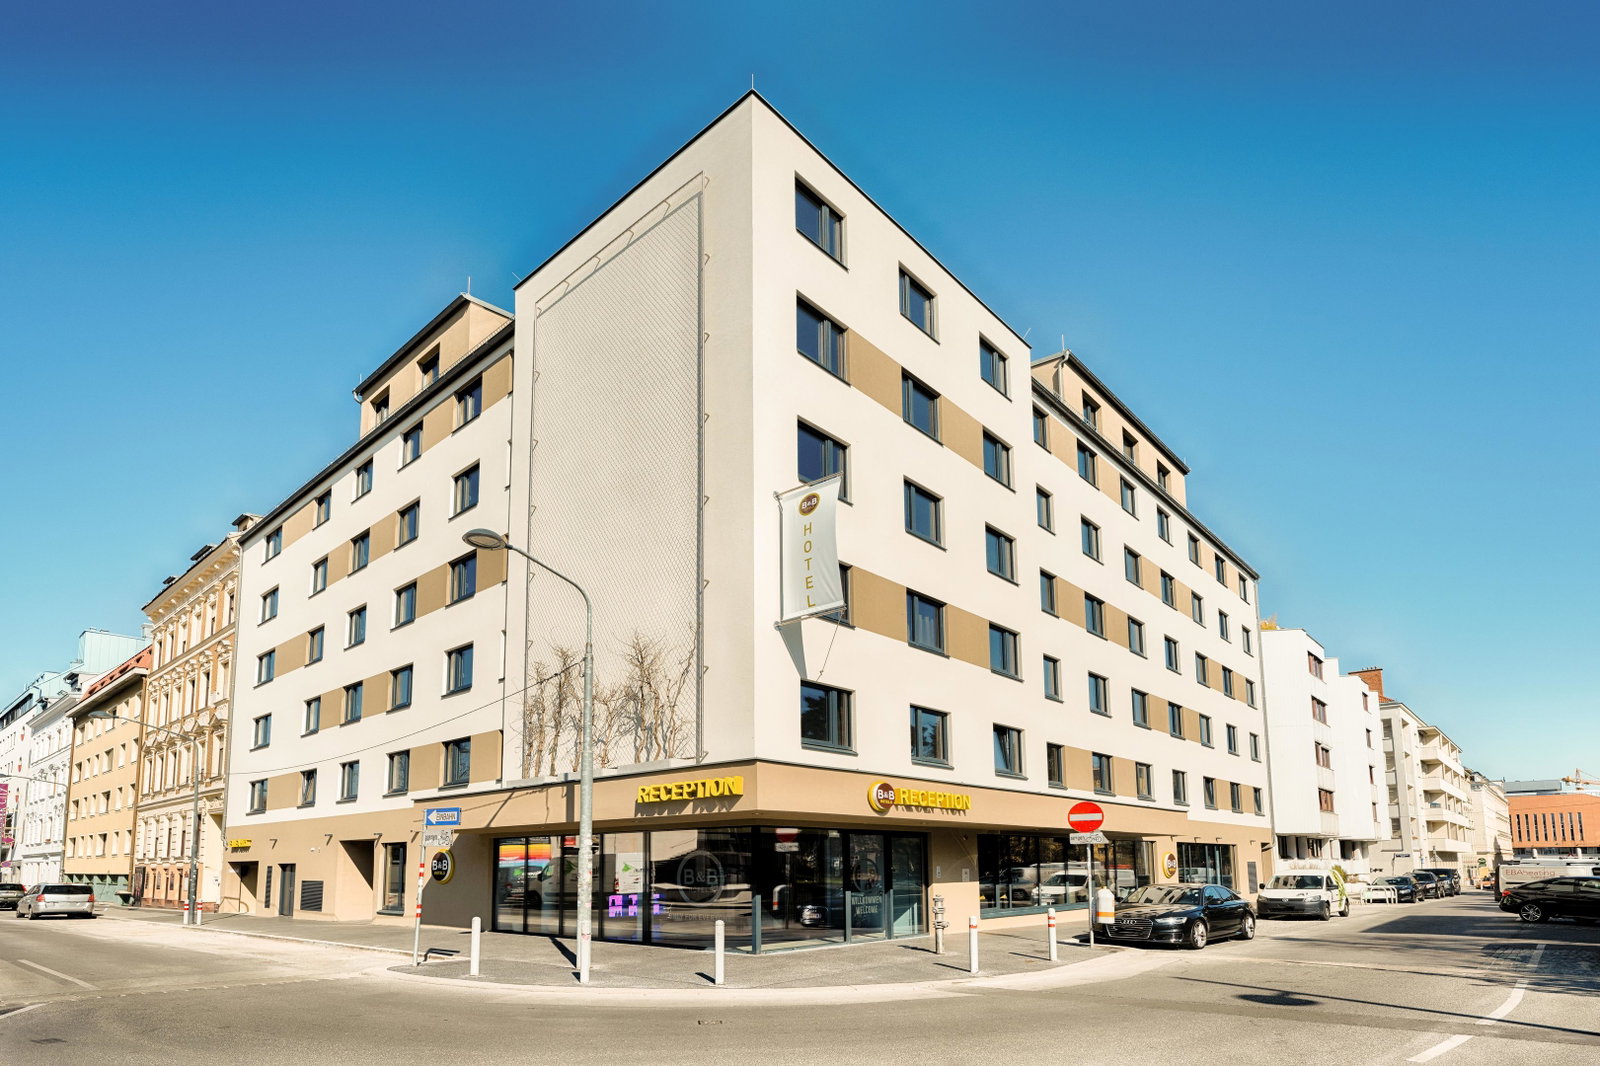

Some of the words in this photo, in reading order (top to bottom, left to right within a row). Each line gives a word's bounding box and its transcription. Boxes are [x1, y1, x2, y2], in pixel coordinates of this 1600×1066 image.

[803, 522, 816, 608] HOTEL
[637, 776, 743, 803] RECEPTION
[877, 789, 895, 800] B&B
[900, 788, 971, 809] RECEPTION
[432, 860, 448, 870] B&B
[683, 868, 719, 885] B&B
